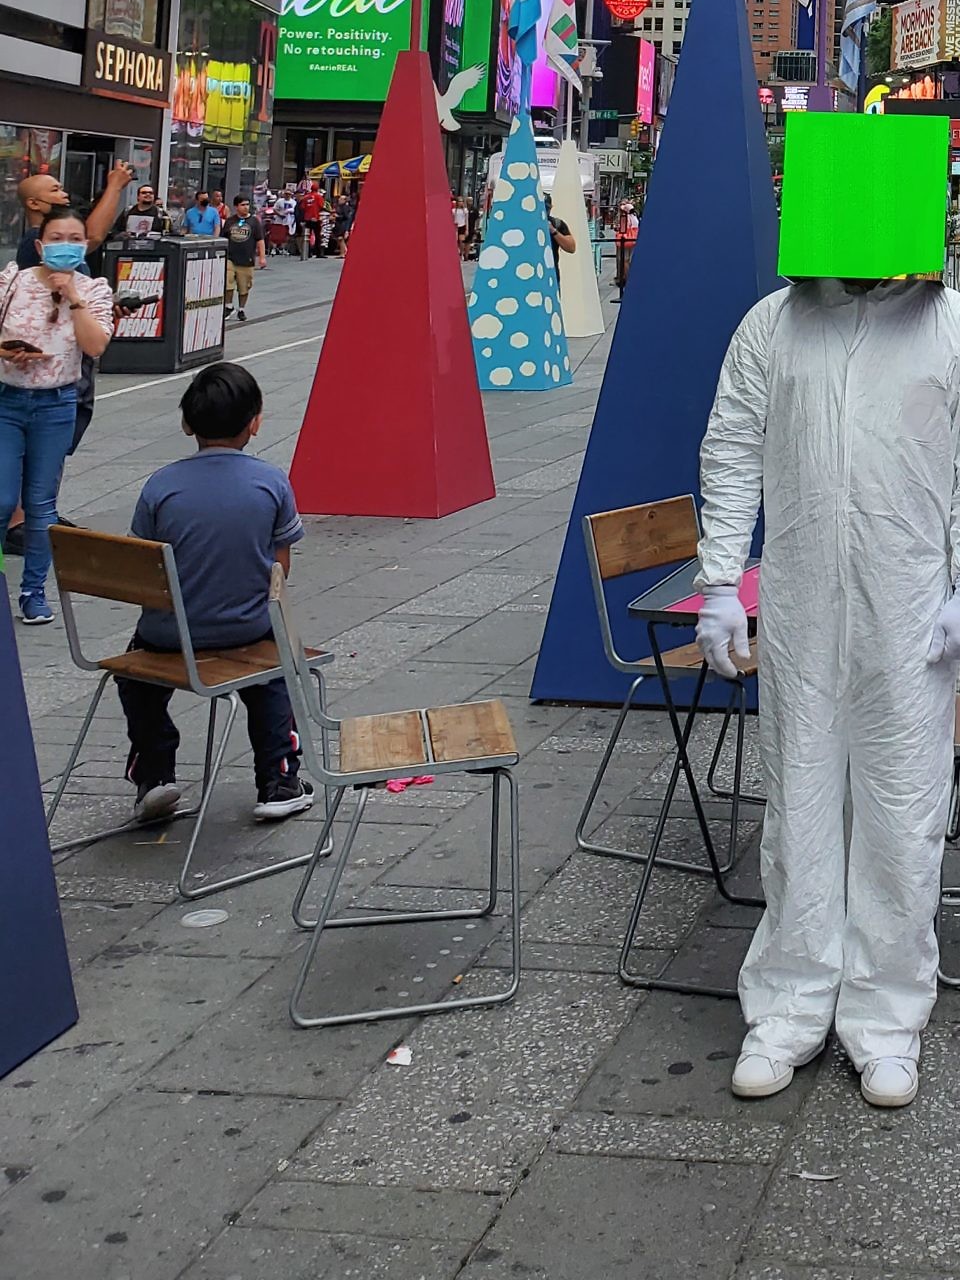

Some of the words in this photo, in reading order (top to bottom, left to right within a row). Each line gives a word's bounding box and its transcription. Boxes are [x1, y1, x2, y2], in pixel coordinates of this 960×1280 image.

[900, 5, 935, 35] MORMONS
[279, 28, 322, 40] Power.
[327, 28, 393, 42] Positivity.
[900, 32, 914, 55] ARE
[914, 27, 935, 51] BACK!
[284, 44, 302, 55] No
[307, 44, 386, 59] retouching.
[945, 36, 955, 57] WE
[96, 41, 164, 93] SEPHORA
[115, 317, 160, 338] PEOPLE
